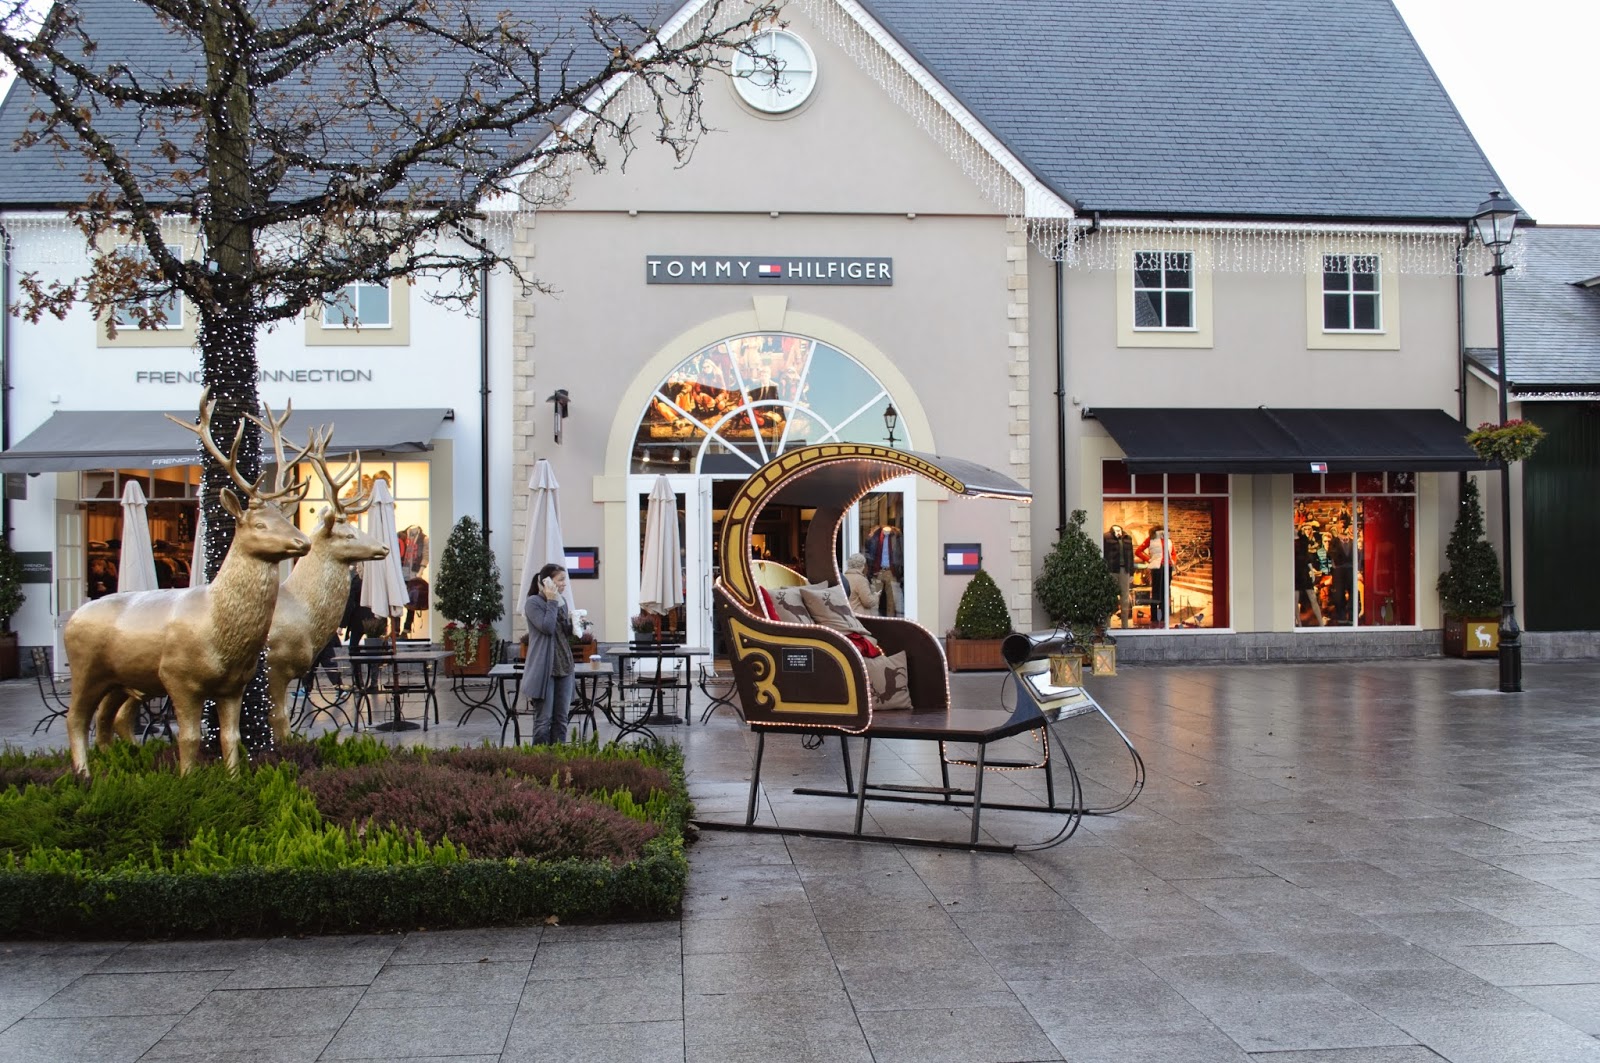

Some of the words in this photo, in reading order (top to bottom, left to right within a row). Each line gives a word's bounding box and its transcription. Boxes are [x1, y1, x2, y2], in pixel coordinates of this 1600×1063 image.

[648, 261, 751, 277] TOMMY
[788, 262, 891, 278] HILFIGER
[137, 371, 203, 383] FRENC
[254, 369, 372, 382] NNECTION
[152, 457, 196, 465] FRENCH
